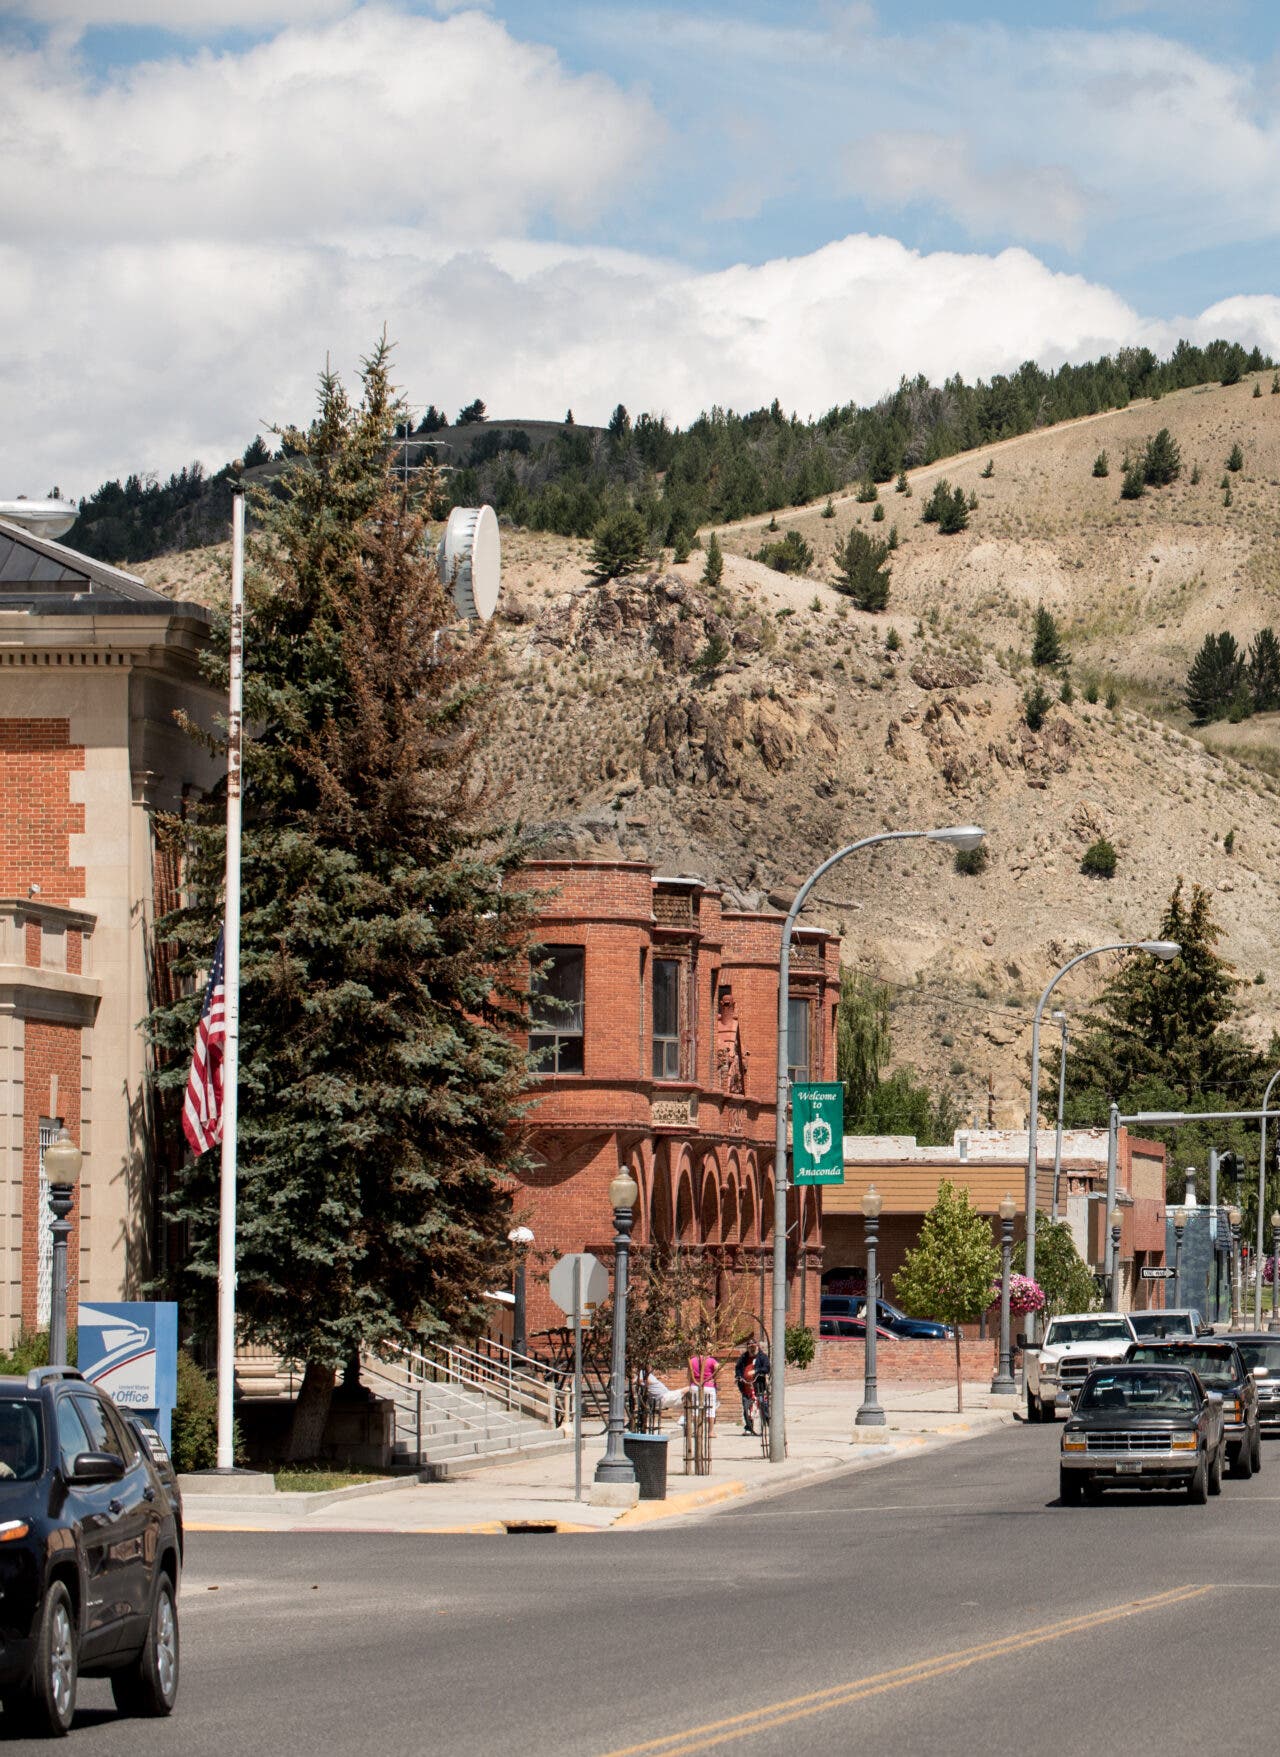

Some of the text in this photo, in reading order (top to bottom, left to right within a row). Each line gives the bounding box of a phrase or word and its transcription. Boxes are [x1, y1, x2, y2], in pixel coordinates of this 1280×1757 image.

[797, 1091, 837, 1101] Welcome
[796, 1166, 842, 1178] Anaconda
[116, 1390, 149, 1403] Office
